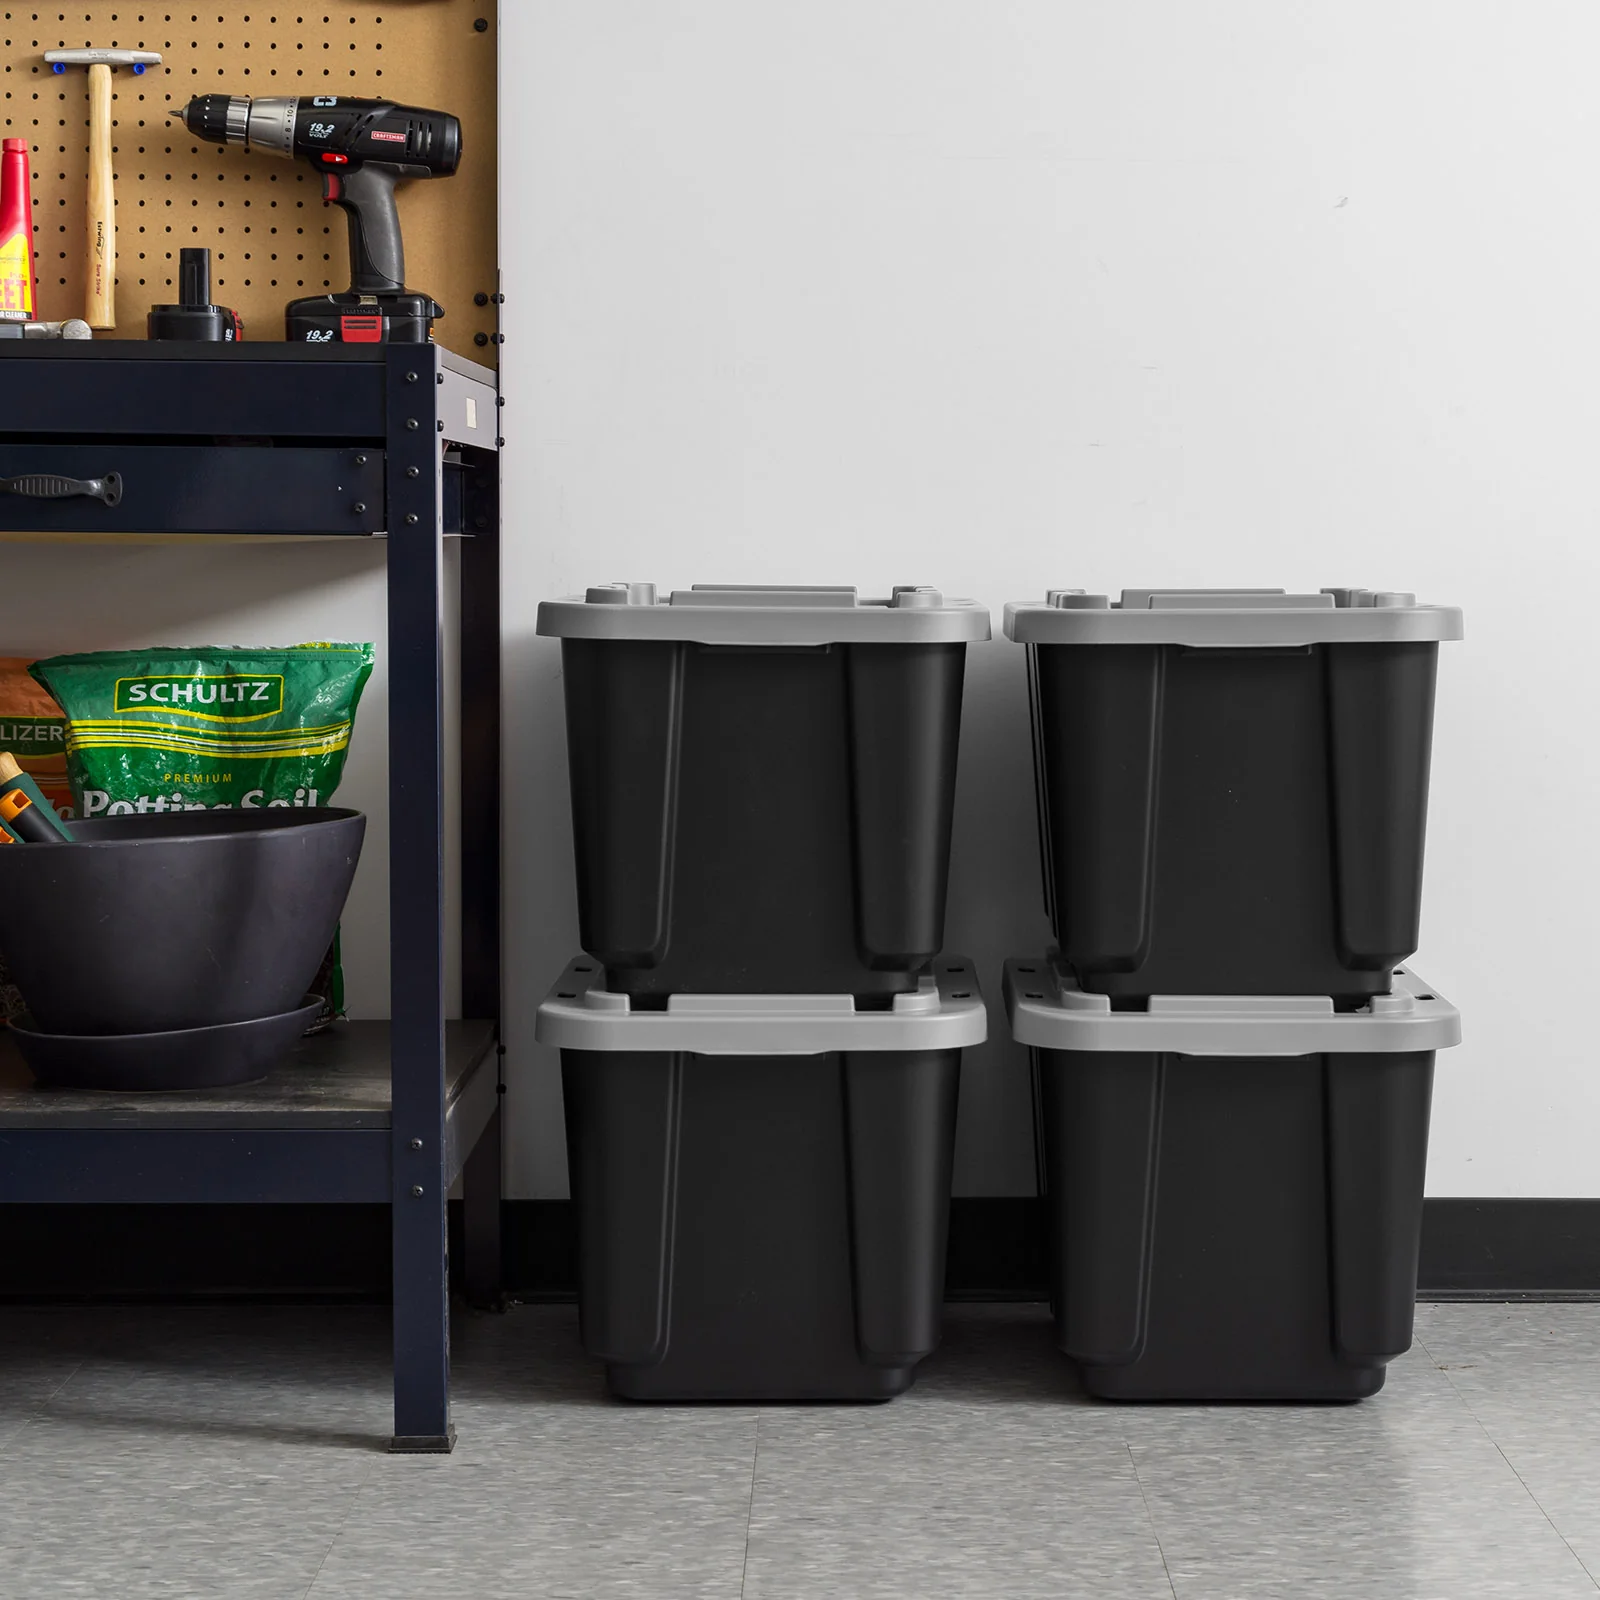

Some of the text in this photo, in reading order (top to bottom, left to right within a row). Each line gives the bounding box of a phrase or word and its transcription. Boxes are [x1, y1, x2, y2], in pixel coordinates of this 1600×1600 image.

[310, 122, 335, 135] 19.2
[373, 132, 404, 140] CRAFTSMAN
[306, 330, 334, 342] 19.2
[129, 682, 270, 704] SCHULTZ
[0, 725, 63, 741] LIZER
[164, 773, 232, 784] PREMIUM
